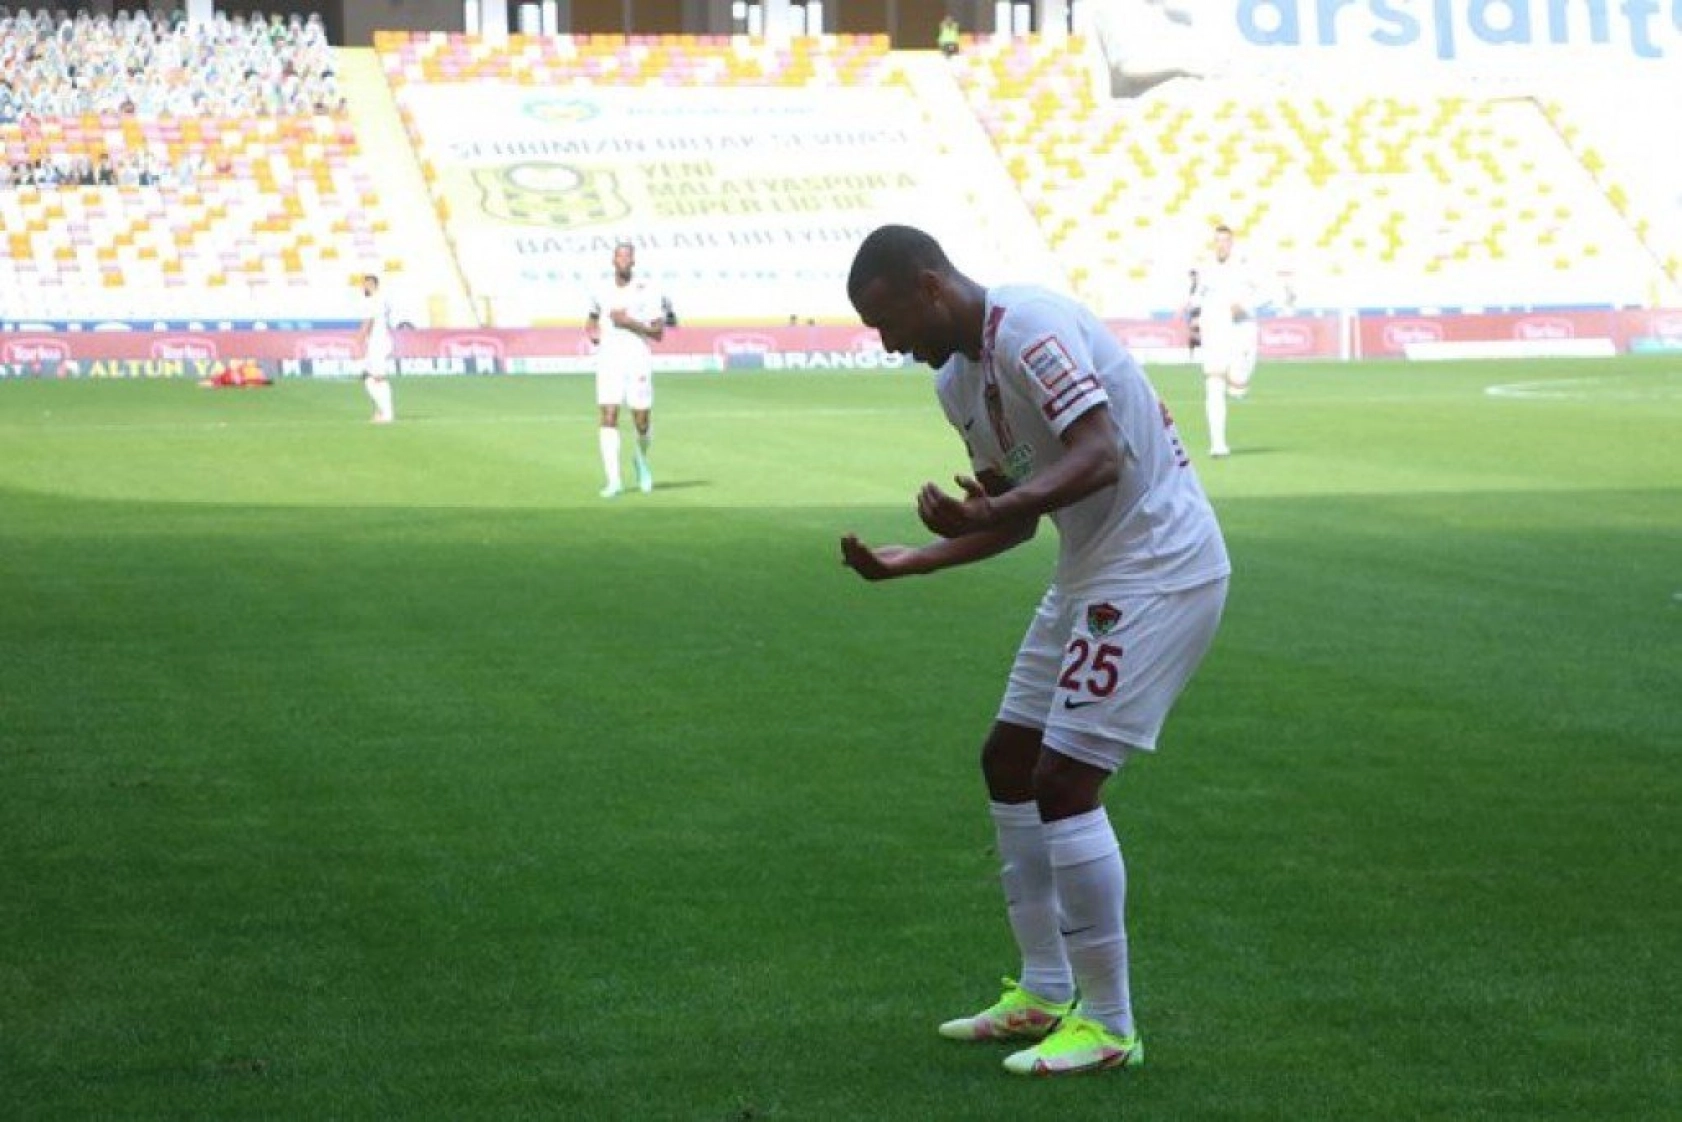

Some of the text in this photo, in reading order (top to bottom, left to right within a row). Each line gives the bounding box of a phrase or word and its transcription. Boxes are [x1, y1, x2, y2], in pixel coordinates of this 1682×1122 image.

[1236, 0, 1682, 60] arslant
[90, 359, 184, 378] ALTUN
[1058, 638, 1123, 697] 25
